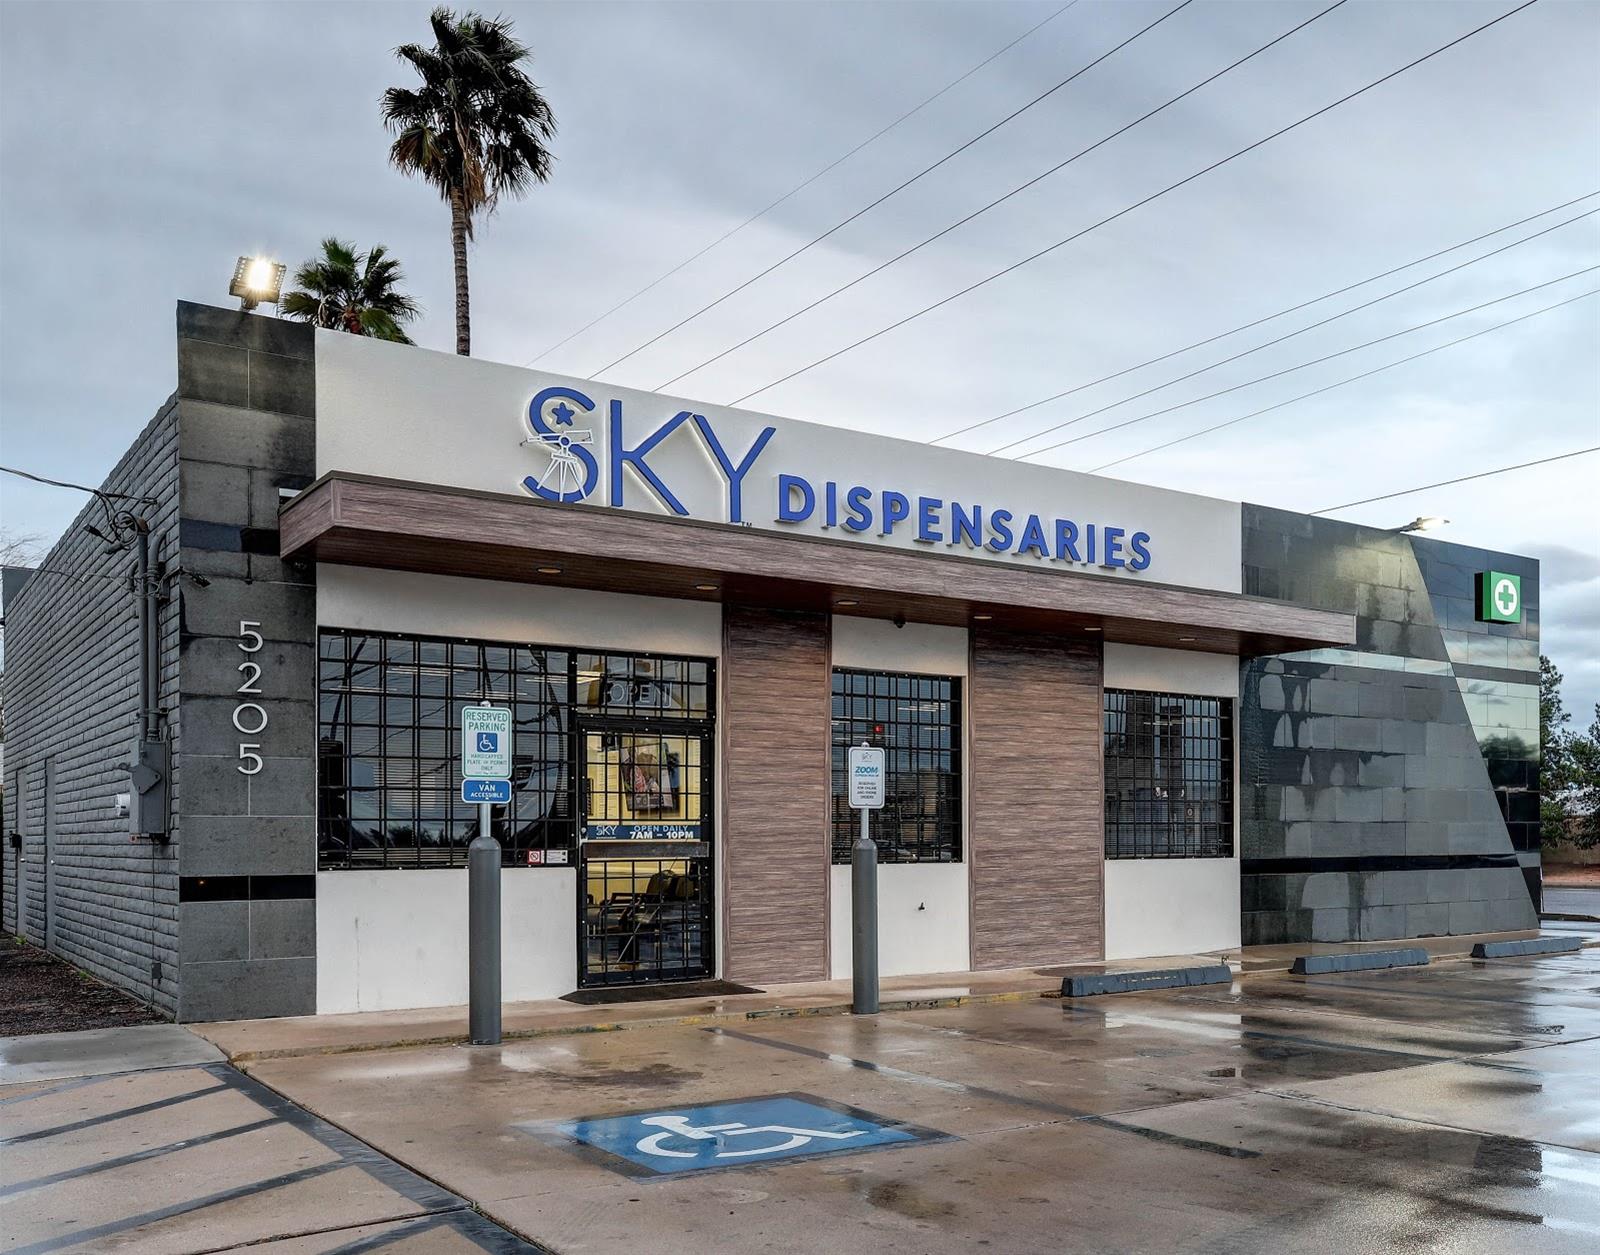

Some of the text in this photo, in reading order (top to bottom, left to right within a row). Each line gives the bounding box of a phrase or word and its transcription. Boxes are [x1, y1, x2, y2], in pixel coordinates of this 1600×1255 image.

[522, 386, 777, 523] SKY
[777, 473, 1151, 572] DISPENSARIES
[232, 620, 268, 775] 5205
[609, 683, 668, 703] OPEN
[466, 711, 508, 722] RESERVED
[468, 722, 506, 732] PARKING
[855, 766, 879, 774] ZOOM
[479, 784, 496, 792] VAN
[595, 825, 618, 836] SKY
[629, 831, 653, 839] 7AM
[666, 831, 694, 840] 10PM
